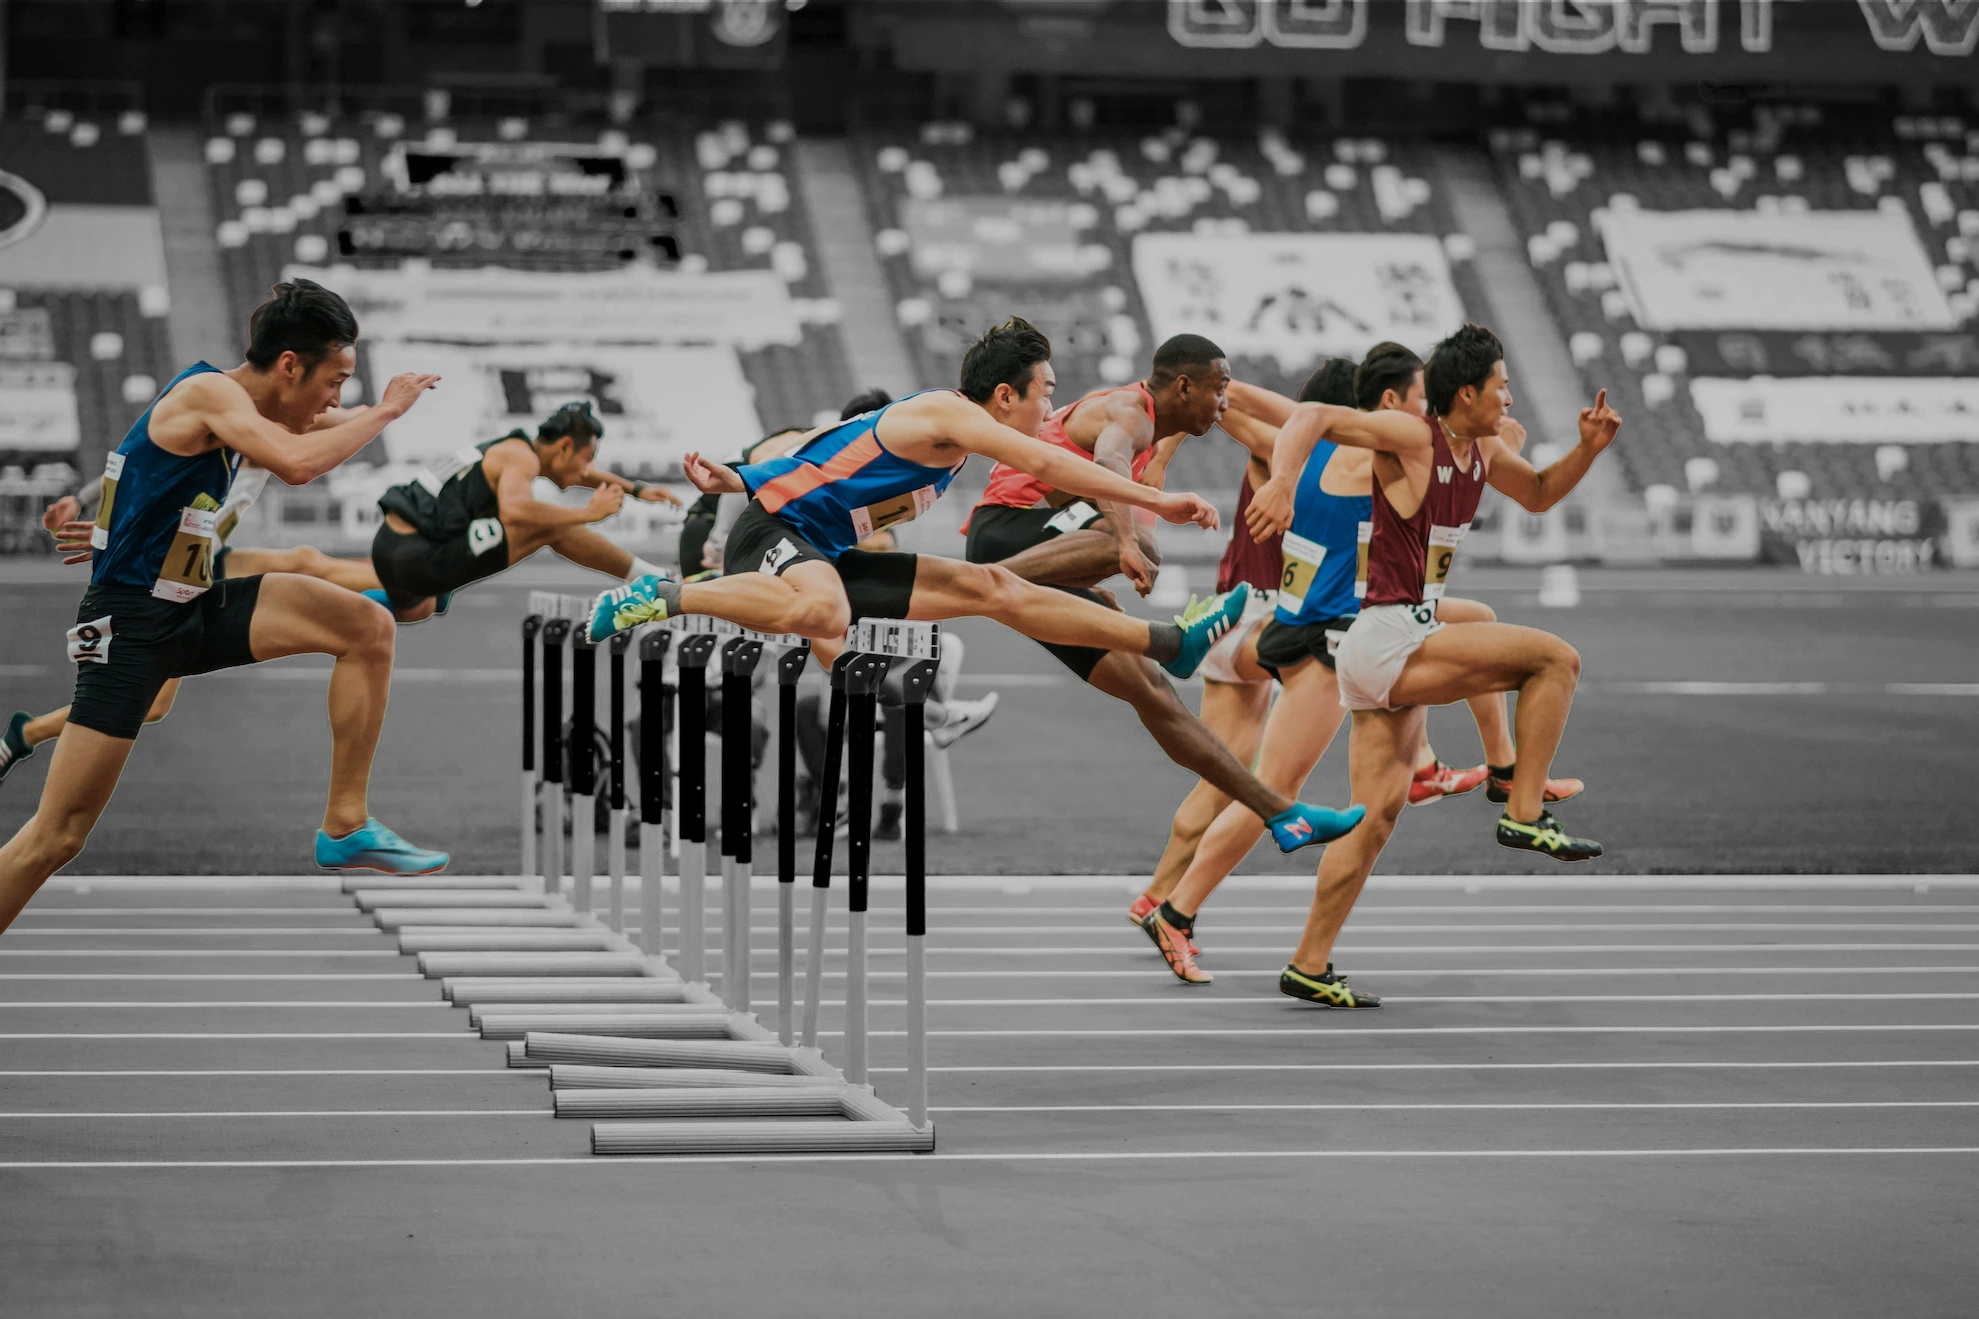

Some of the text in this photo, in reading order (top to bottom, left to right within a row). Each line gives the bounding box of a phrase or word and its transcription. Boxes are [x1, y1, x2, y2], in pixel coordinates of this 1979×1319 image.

[1436, 465, 1453, 484] W
[1283, 562, 1298, 588] 6
[1436, 551, 1453, 579] 9
[77, 624, 103, 652] 9
